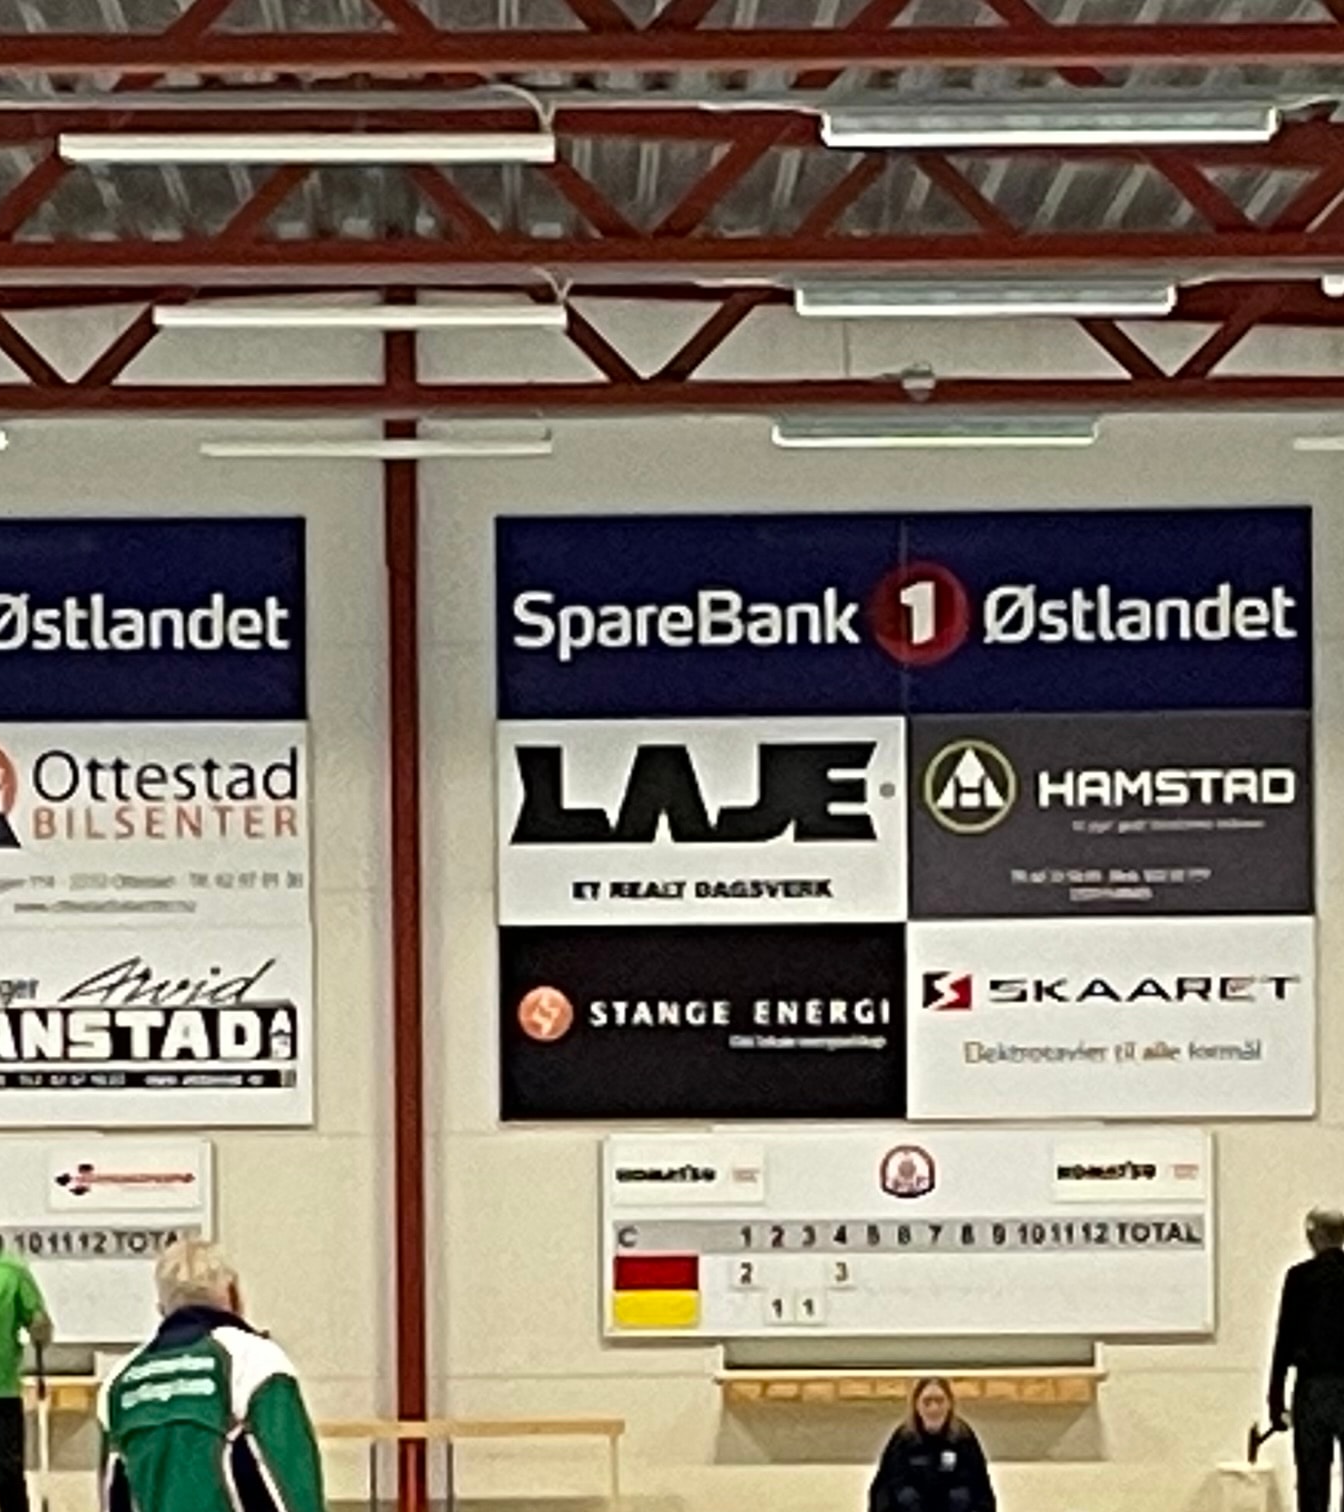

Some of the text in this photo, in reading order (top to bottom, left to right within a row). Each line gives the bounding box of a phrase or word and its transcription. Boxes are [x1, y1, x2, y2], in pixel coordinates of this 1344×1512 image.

[513, 581, 1297, 662] SpareBank 1 Østlandet
[32, 746, 298, 803] Ottestad
[1038, 768, 1295, 808] HAMSTAD
[510, 741, 877, 845] LAJE
[32, 808, 299, 841] BILSENTER
[988, 975, 1302, 1003] SKAARET
[590, 998, 890, 1027] STANGE ENERGI
[14, 1231, 43, 1254] 10
[48, 1231, 74, 1254] 11
[78, 1231, 107, 1254] 12
[112, 1231, 181, 1254] TOTA
[617, 1224, 639, 1248] C
[740, 1225, 752, 1247] 1
[770, 1225, 785, 1248] 2
[802, 1225, 817, 1247] 3
[833, 1224, 848, 1246] 4
[928, 1224, 943, 1245] 7
[992, 1222, 1006, 1246] 9
[1017, 1223, 1046, 1245] 10
[1051, 1222, 1075, 1245] 11
[1081, 1222, 1109, 1245] 12
[1117, 1221, 1203, 1245] TOTAL
[740, 1262, 849, 1285] 2 3
[772, 1299, 814, 1319] 1 1
